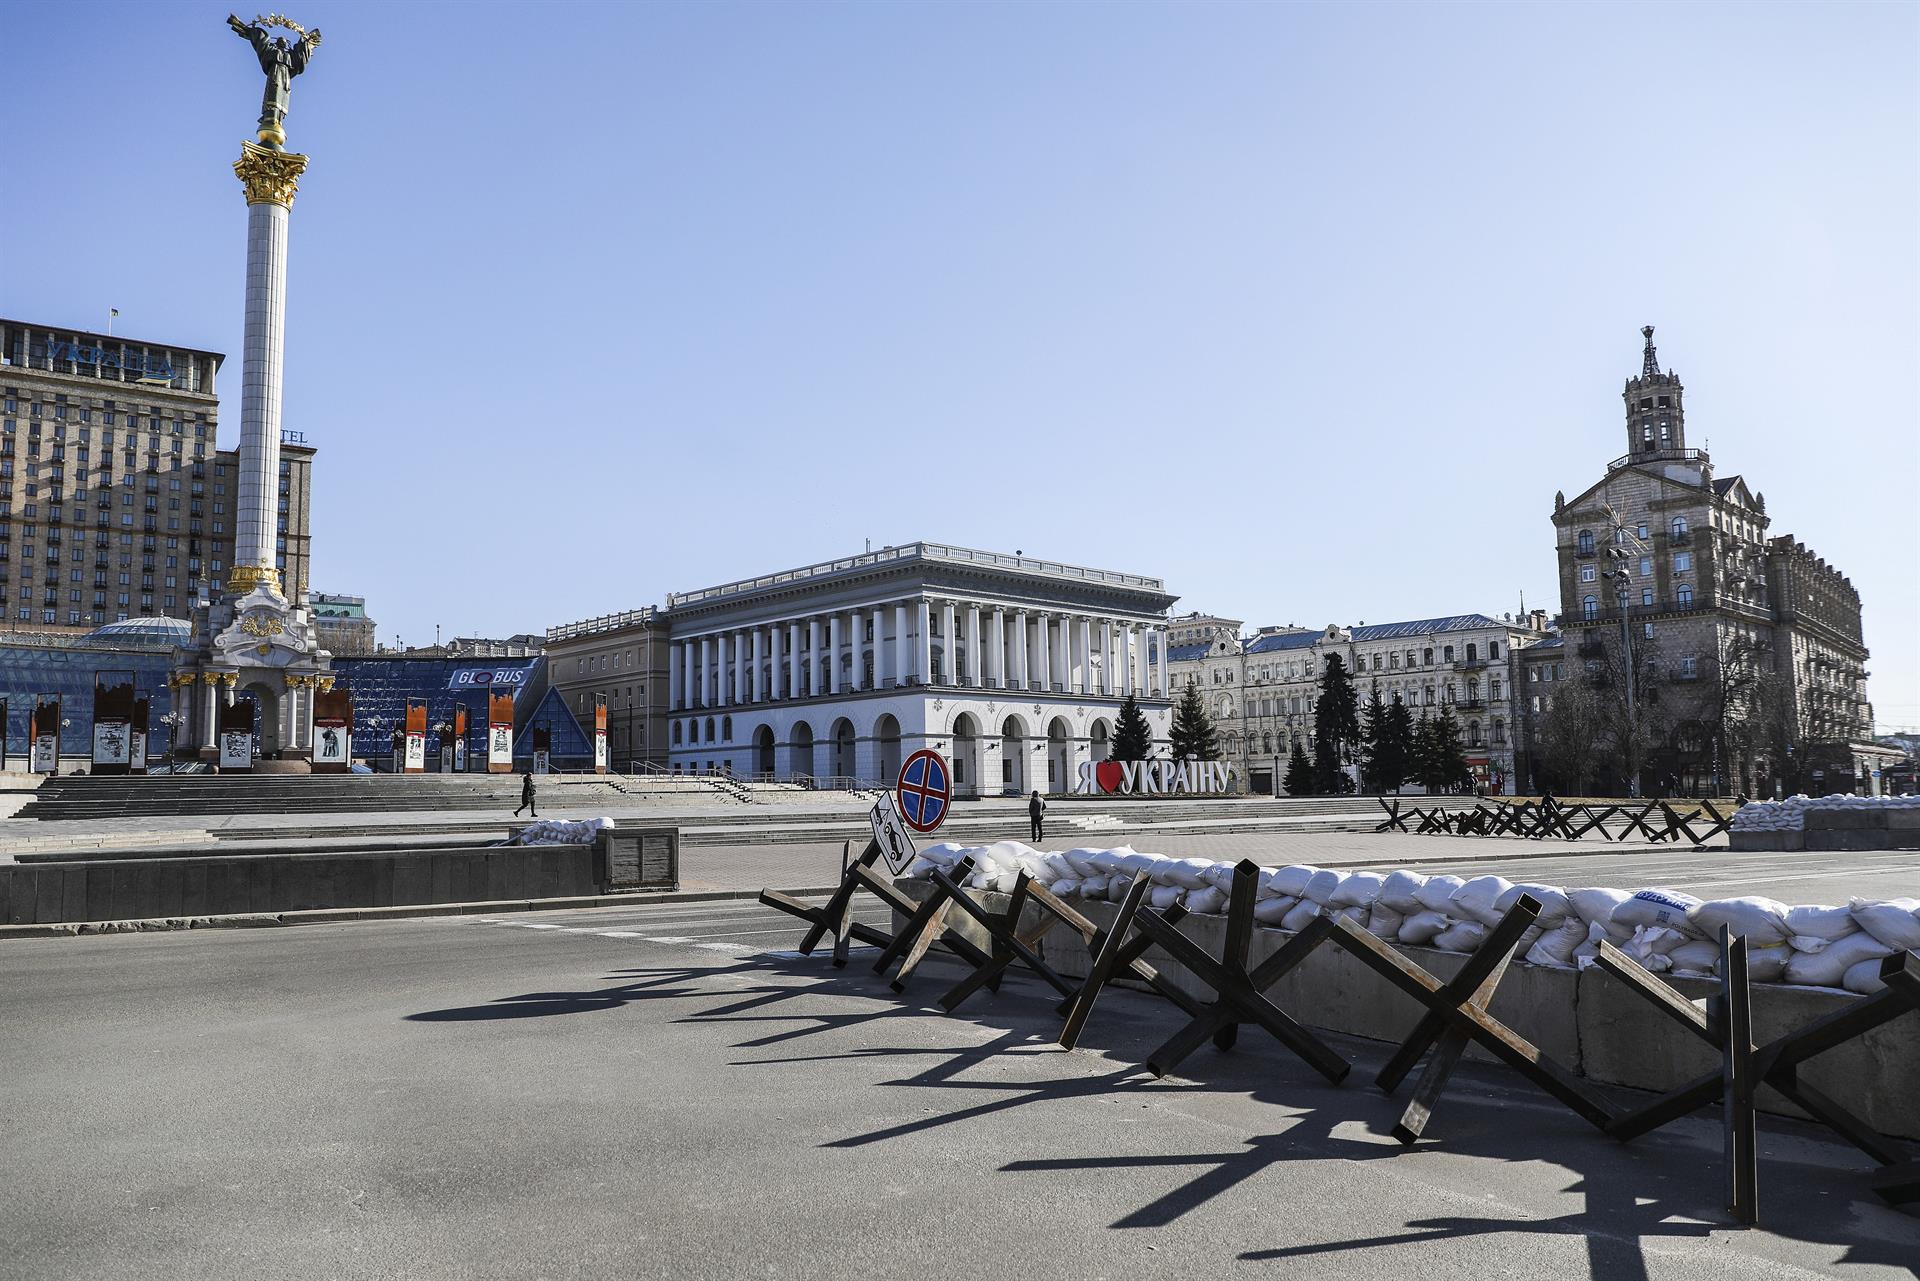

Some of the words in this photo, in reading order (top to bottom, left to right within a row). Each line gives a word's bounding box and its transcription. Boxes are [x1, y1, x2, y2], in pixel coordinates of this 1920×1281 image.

[46, 340, 176, 376] УКРАЇНА
[458, 671, 524, 684] GLOBUS
[1077, 760, 1097, 794] Я
[1120, 754, 1231, 794] УКРАЇНУ
